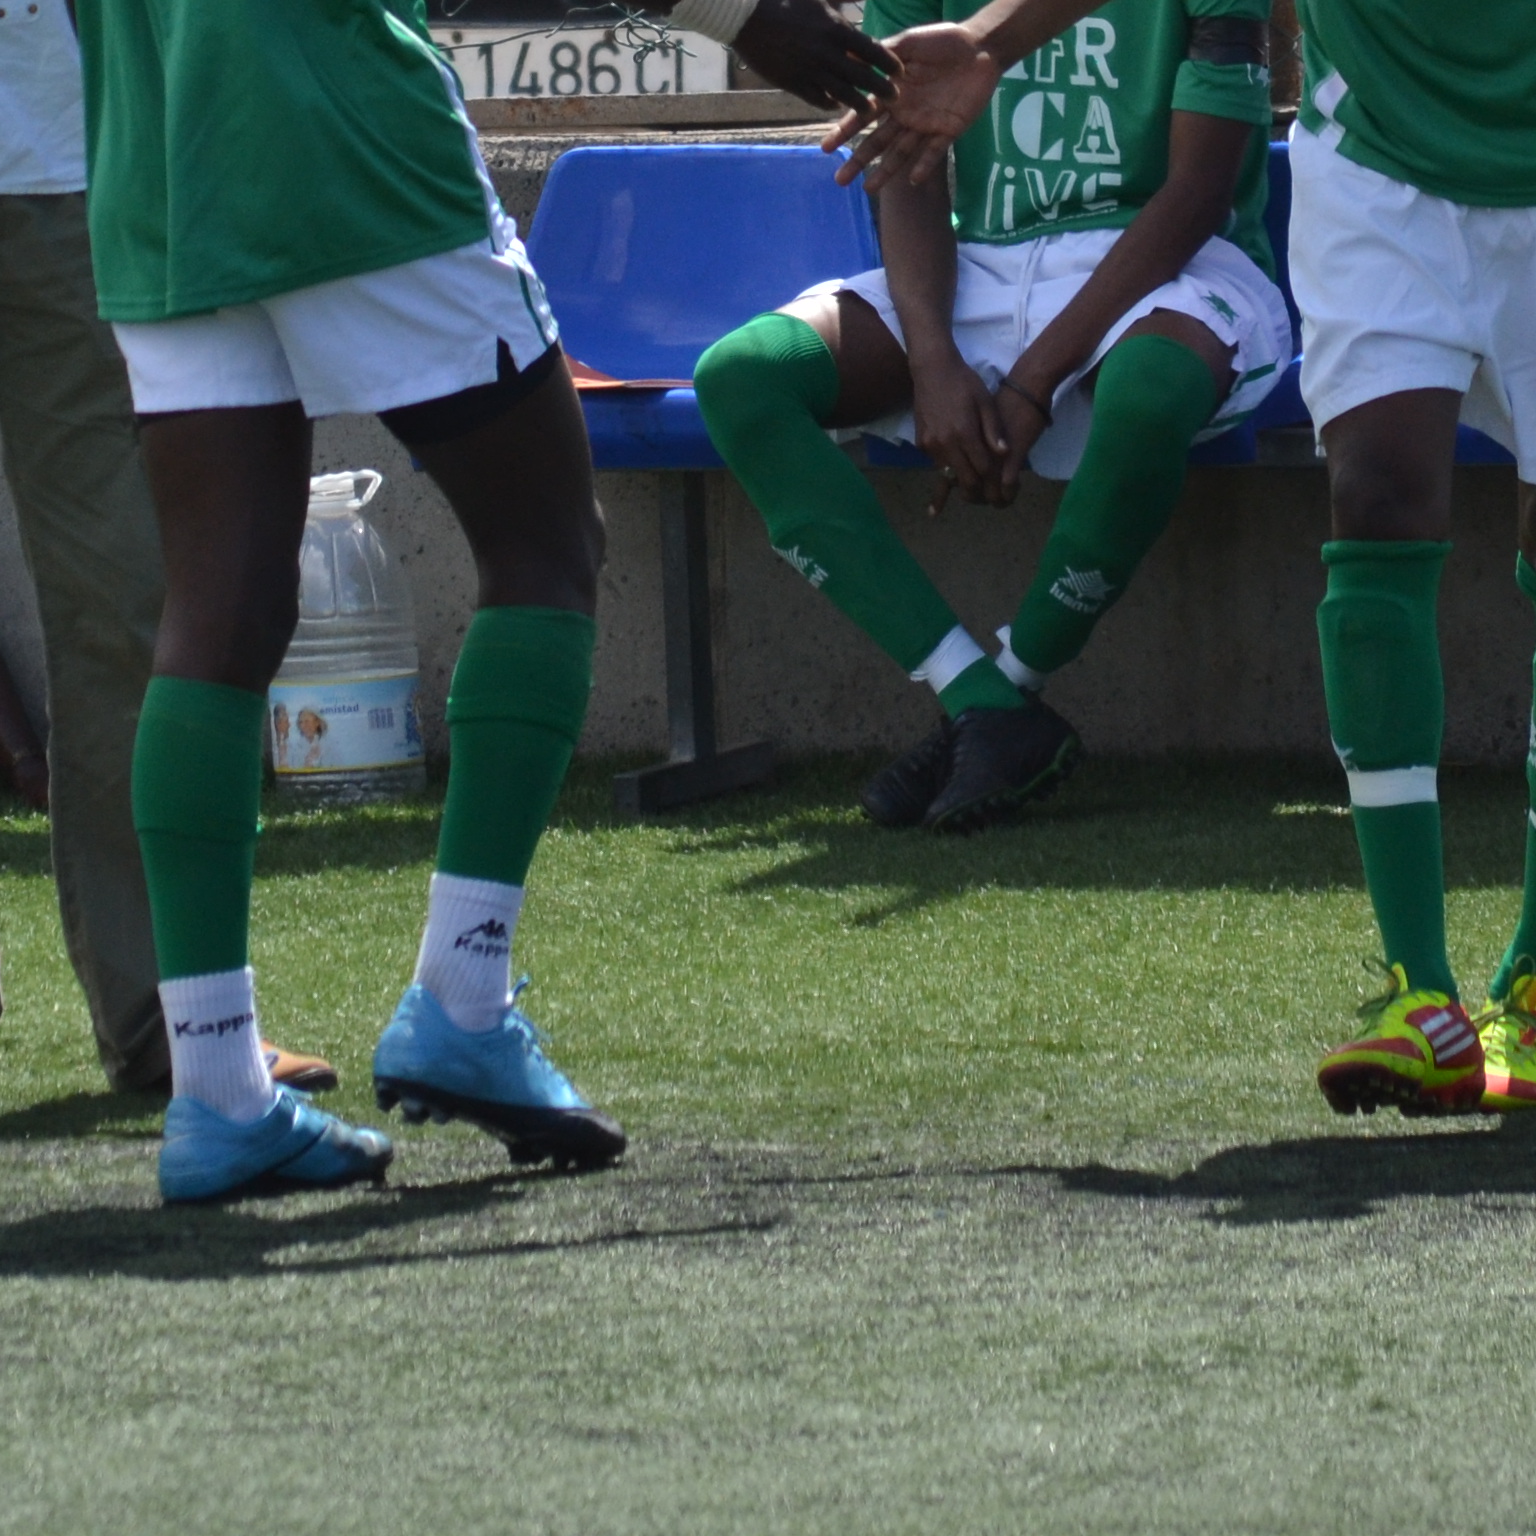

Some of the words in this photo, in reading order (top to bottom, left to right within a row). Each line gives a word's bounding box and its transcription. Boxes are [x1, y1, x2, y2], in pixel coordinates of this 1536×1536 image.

[478, 38, 621, 98] 1486
[1002, 16, 1119, 89] FR
[174, 1013, 253, 1038] Kappa
